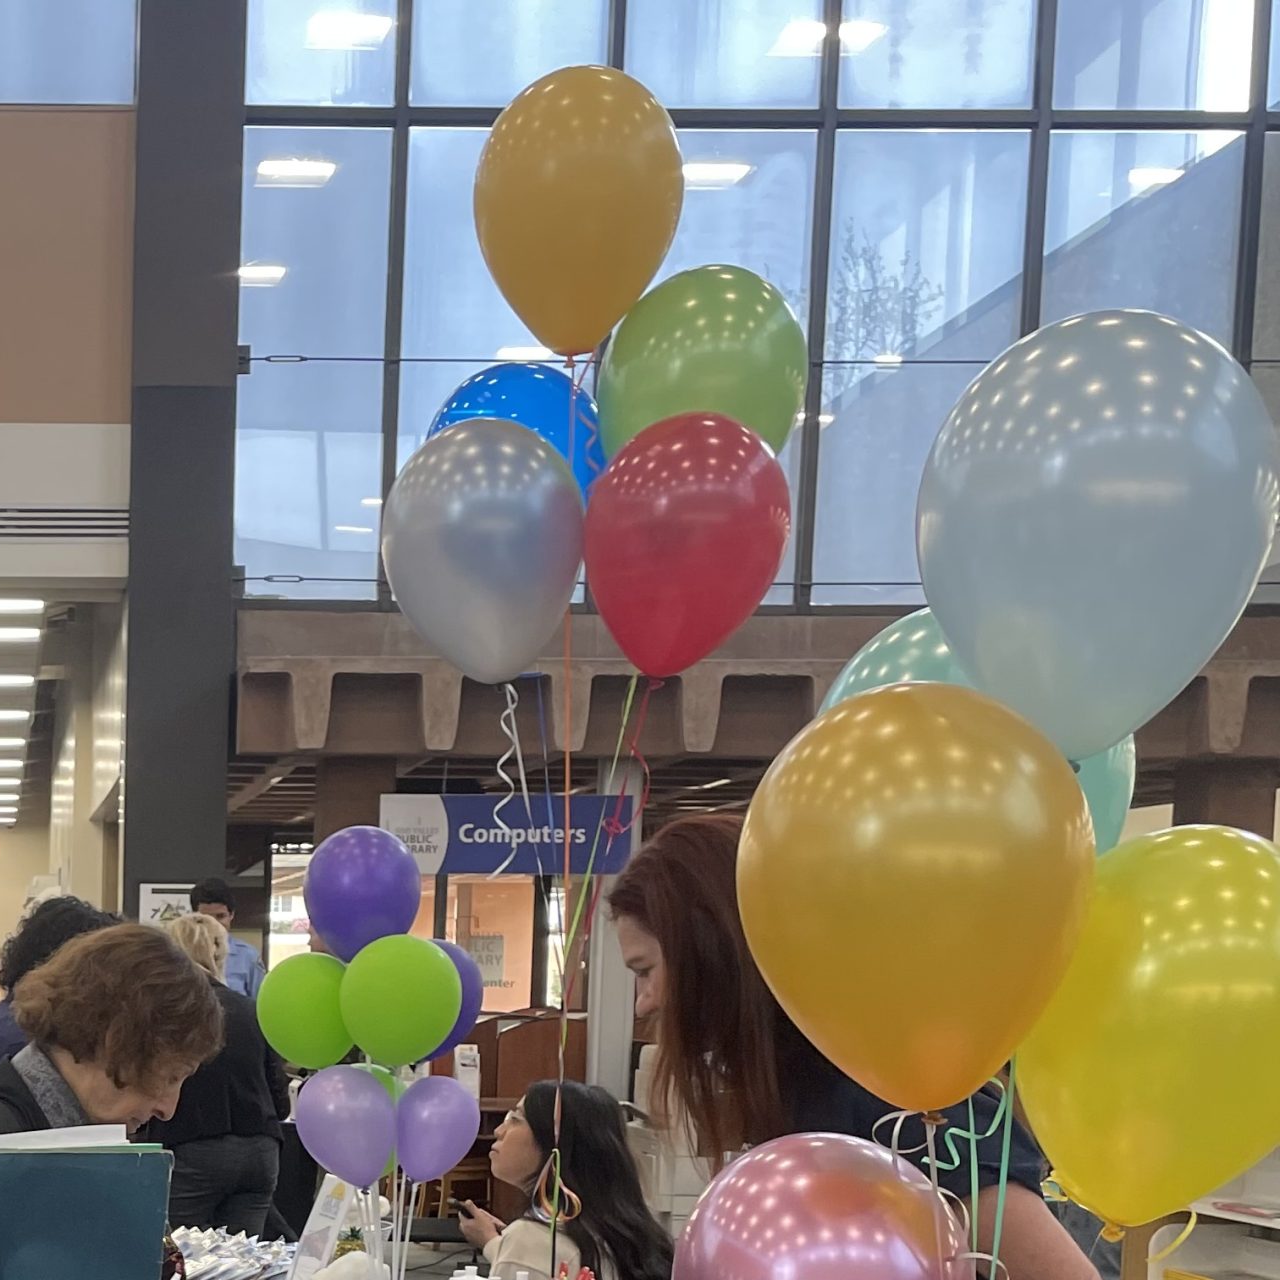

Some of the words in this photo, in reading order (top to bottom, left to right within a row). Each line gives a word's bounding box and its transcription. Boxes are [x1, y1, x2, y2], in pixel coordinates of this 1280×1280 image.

[458, 823, 586, 849] Computers
[406, 844, 439, 854] RARY
[482, 980, 516, 989] enter
